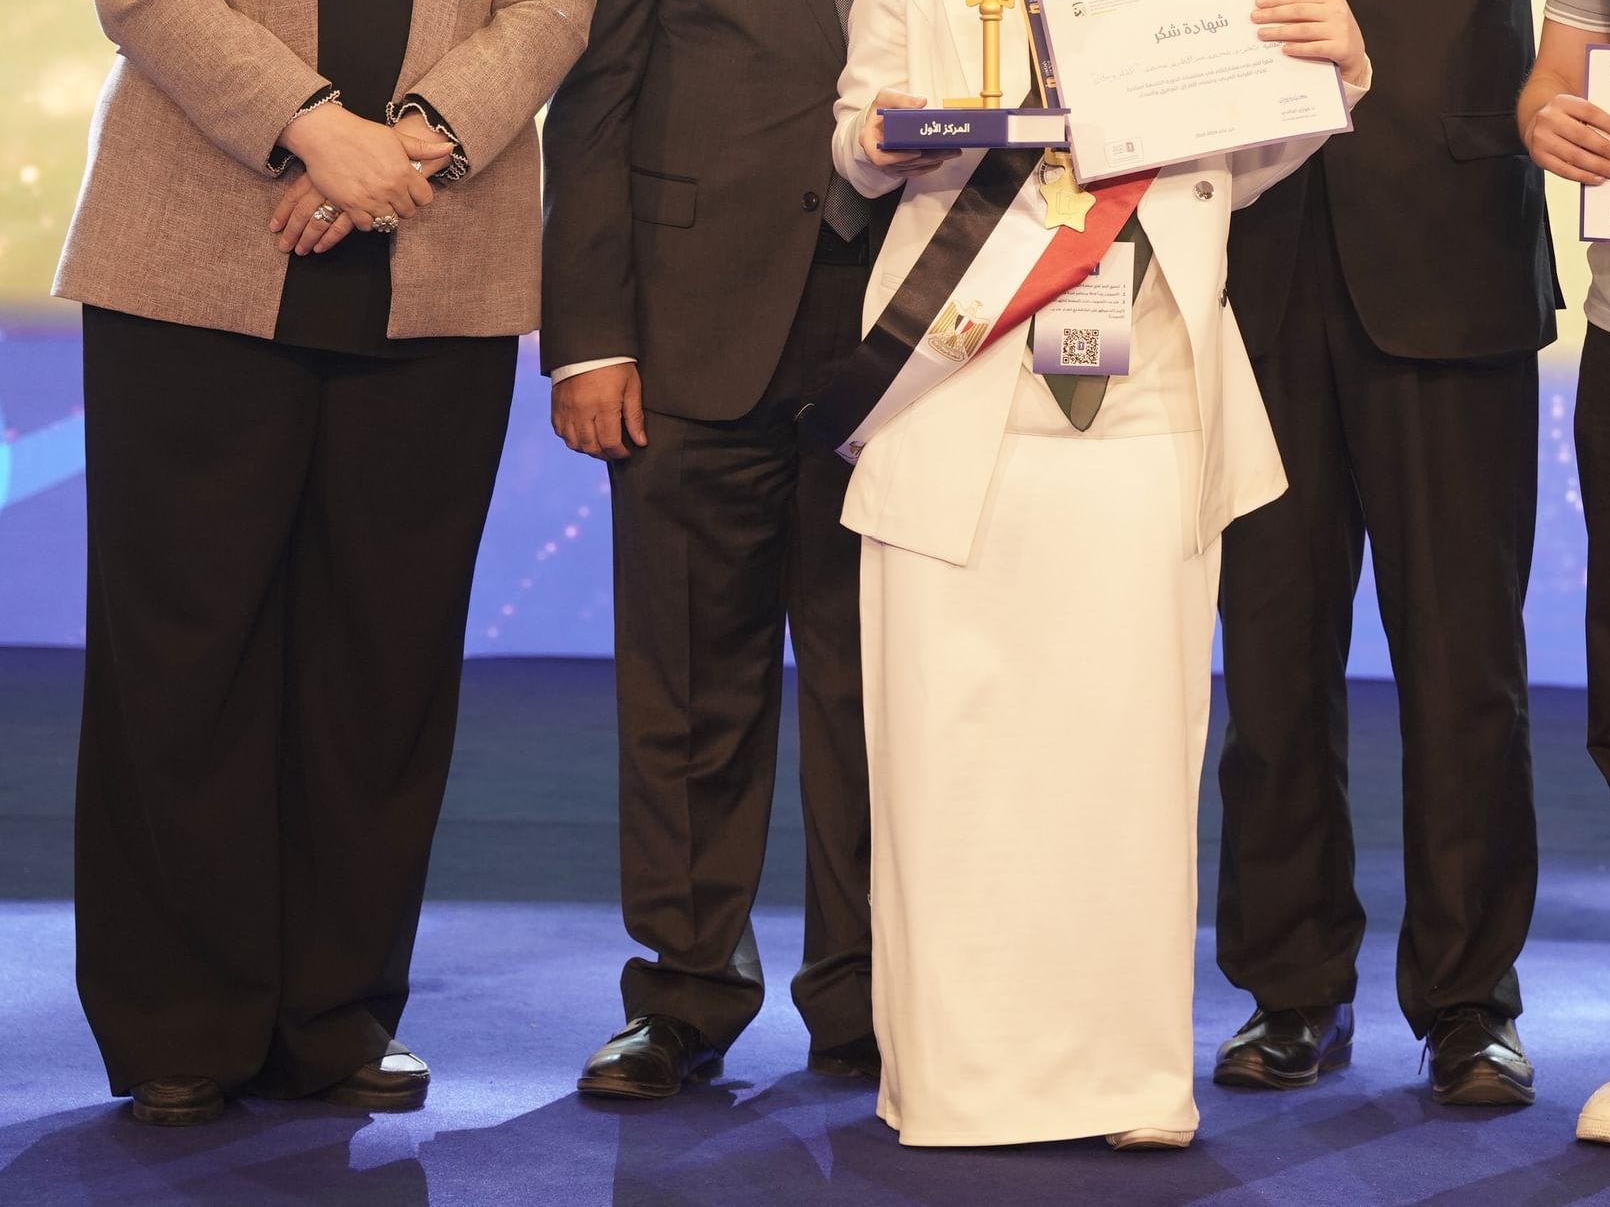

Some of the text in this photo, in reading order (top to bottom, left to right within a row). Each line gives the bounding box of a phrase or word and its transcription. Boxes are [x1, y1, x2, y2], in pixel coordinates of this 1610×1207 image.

[1154, 13, 1229, 44] شهادة شكر
[920, 120, 970, 135] المركز الأول
